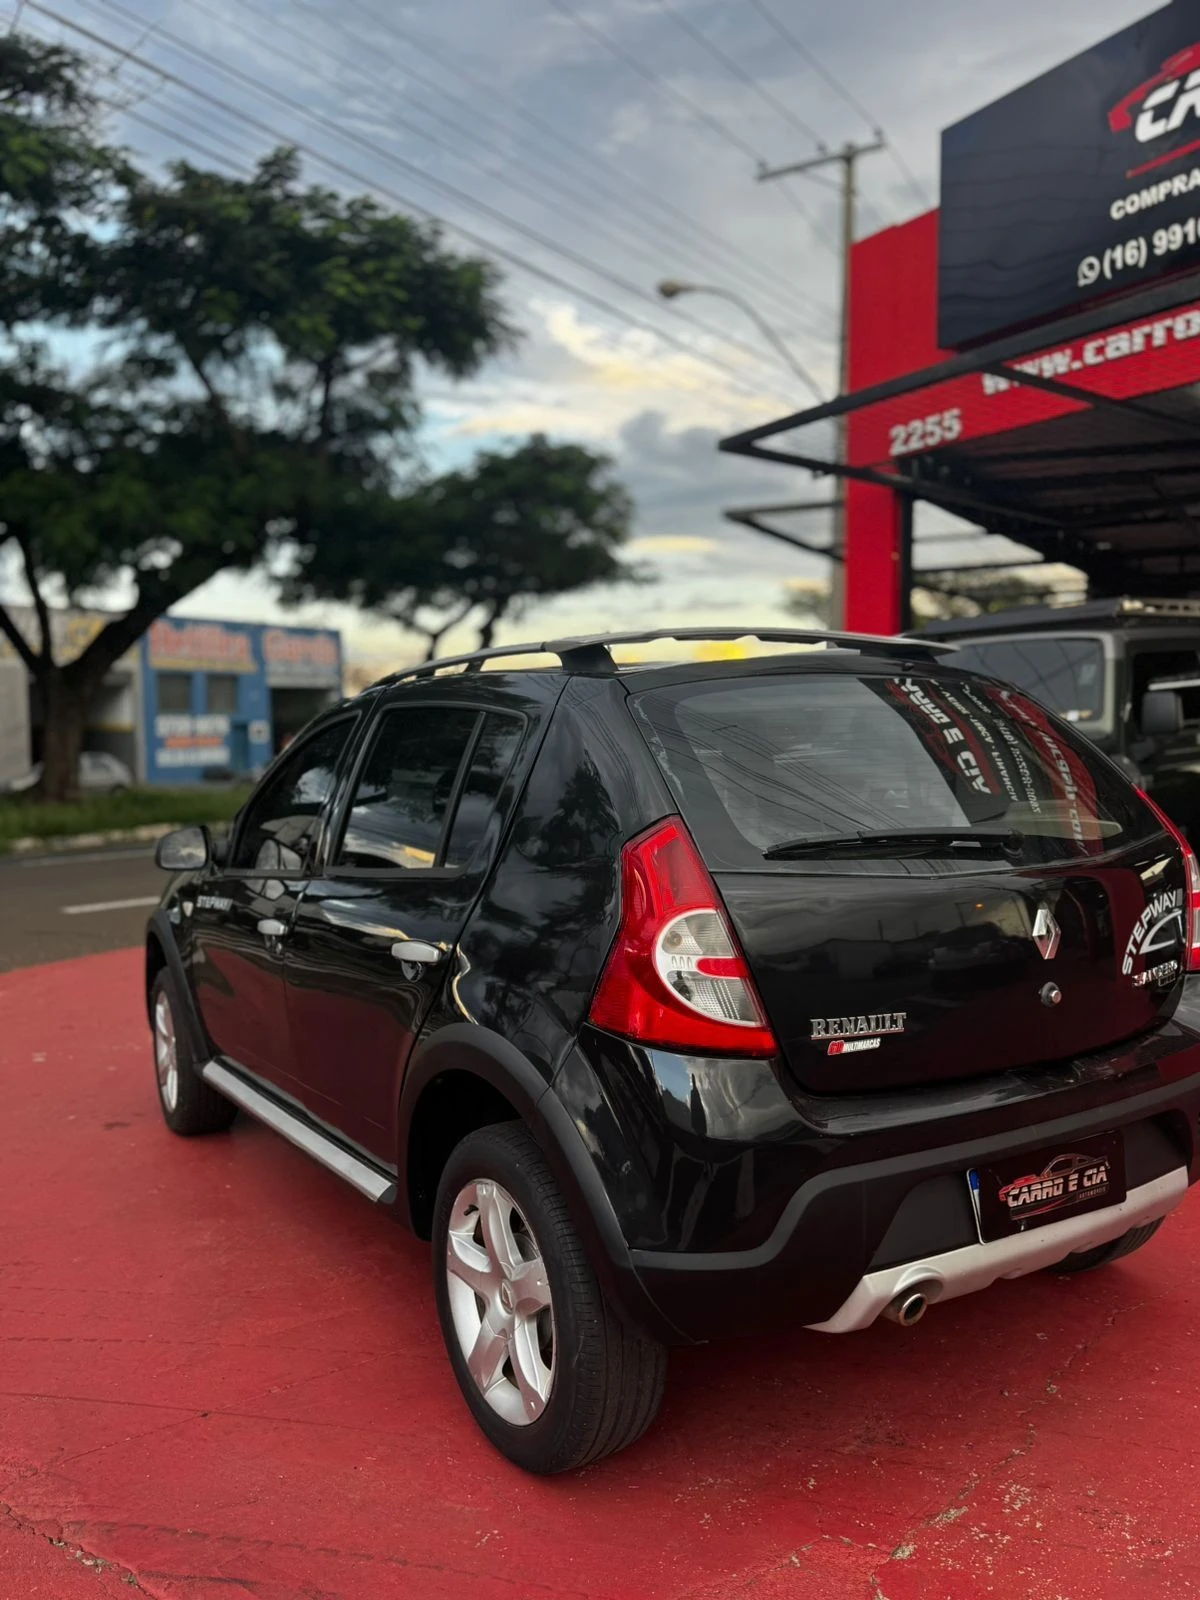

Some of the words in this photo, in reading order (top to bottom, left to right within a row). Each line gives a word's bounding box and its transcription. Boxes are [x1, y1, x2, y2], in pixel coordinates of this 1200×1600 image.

[1103, 236, 1148, 279] (16)
[1152, 217, 1200, 256] 991
[890, 407, 963, 456] 2255
[1122, 889, 1176, 976] STEPWAY
[810, 1012, 907, 1039] RENAULT
[1007, 1178, 1064, 1208] CARRO
[1068, 1172, 1079, 1192] E
